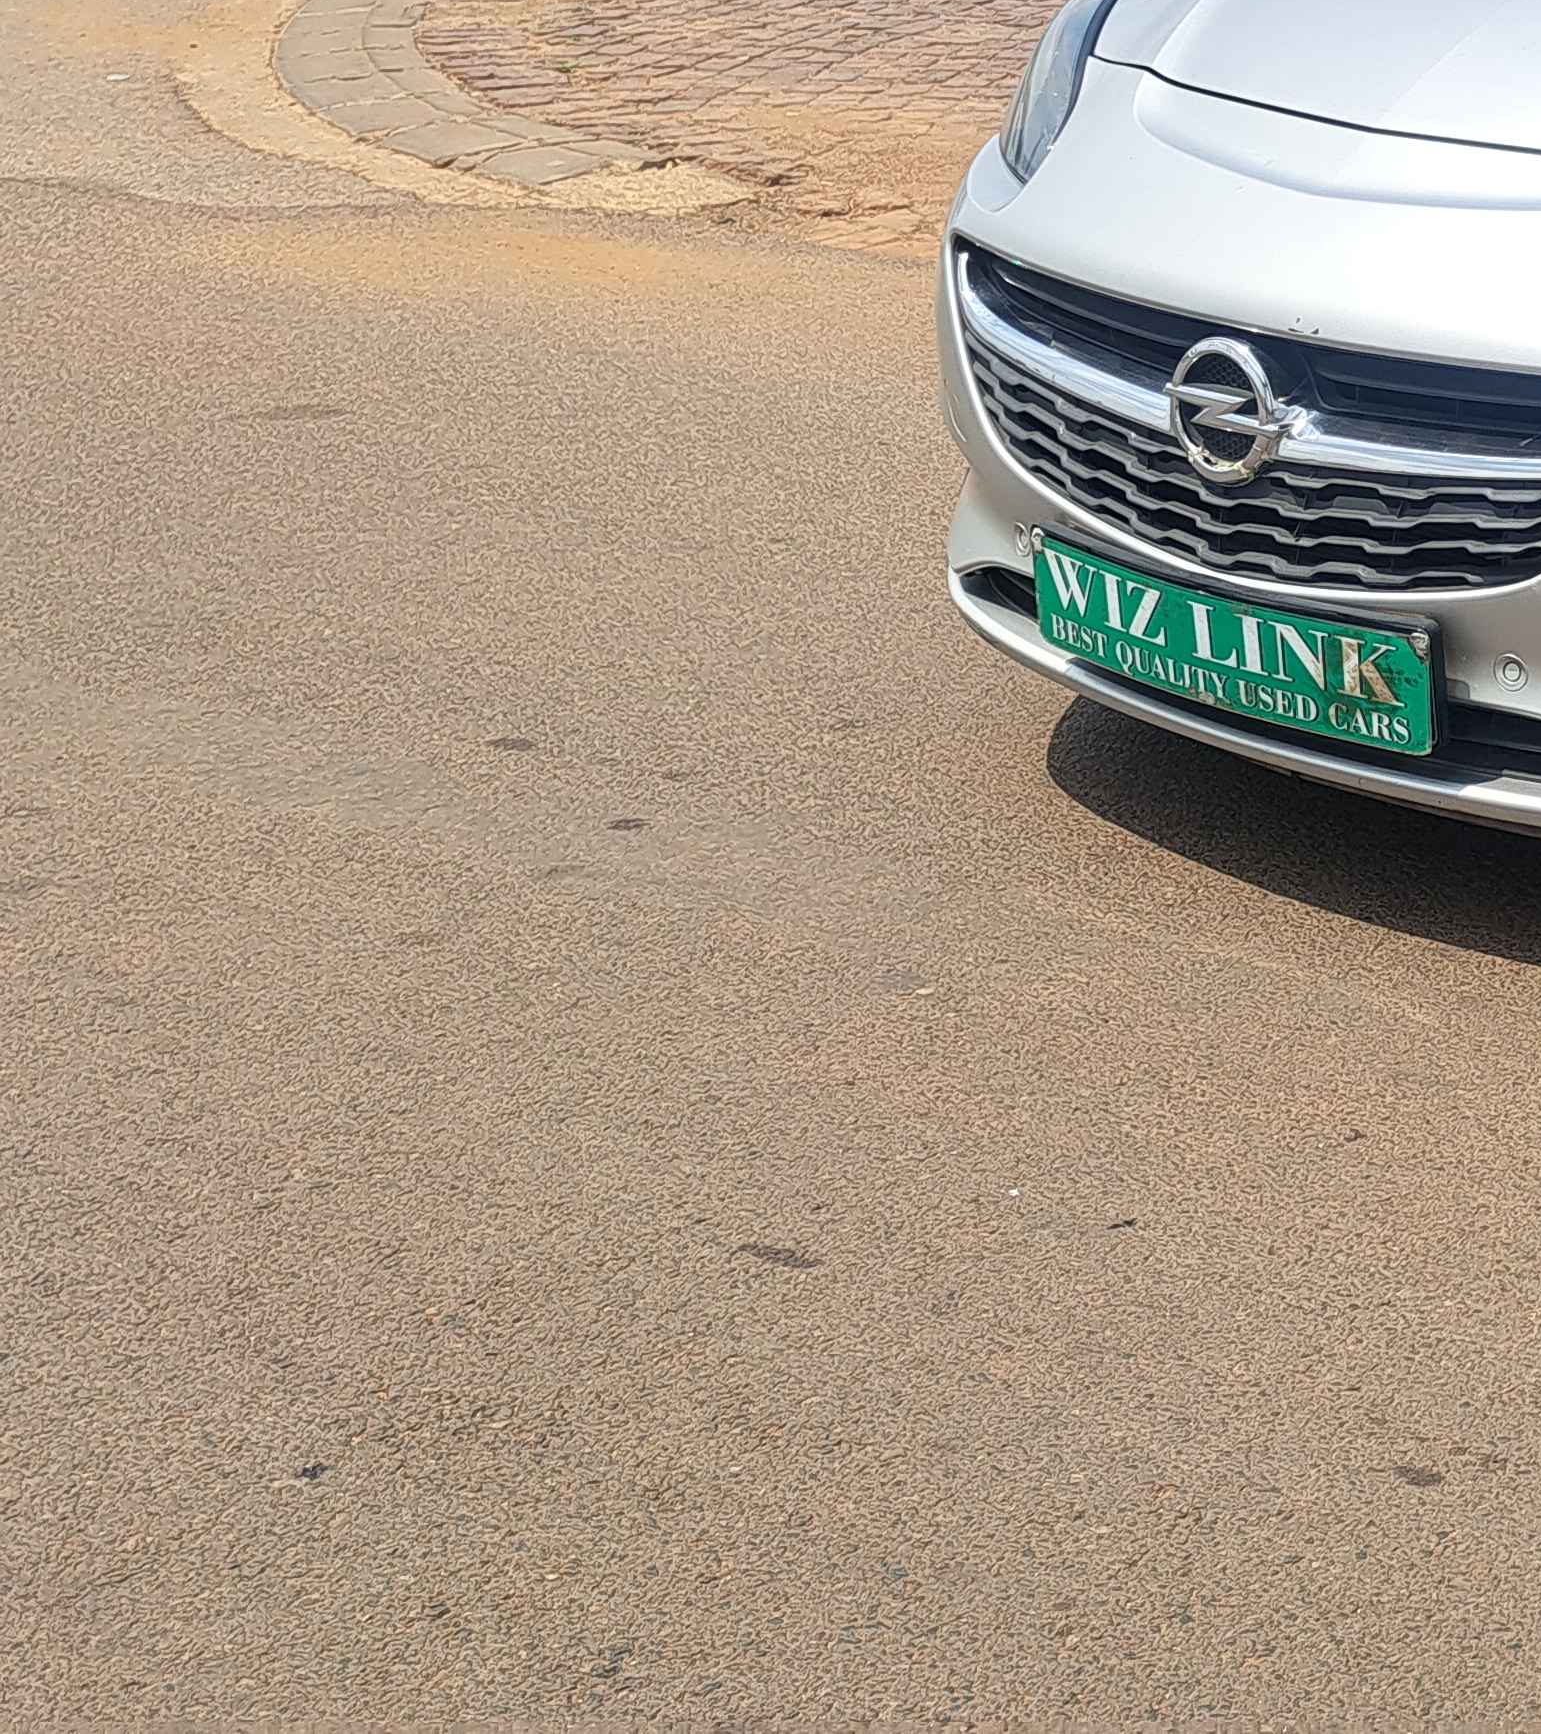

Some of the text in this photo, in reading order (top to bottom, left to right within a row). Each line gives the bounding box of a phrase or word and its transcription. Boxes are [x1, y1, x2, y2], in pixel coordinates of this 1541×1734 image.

[1043, 546, 1406, 708] WIZ LINK
[1050, 611, 1412, 746] BEST QUALITY USED CARS
